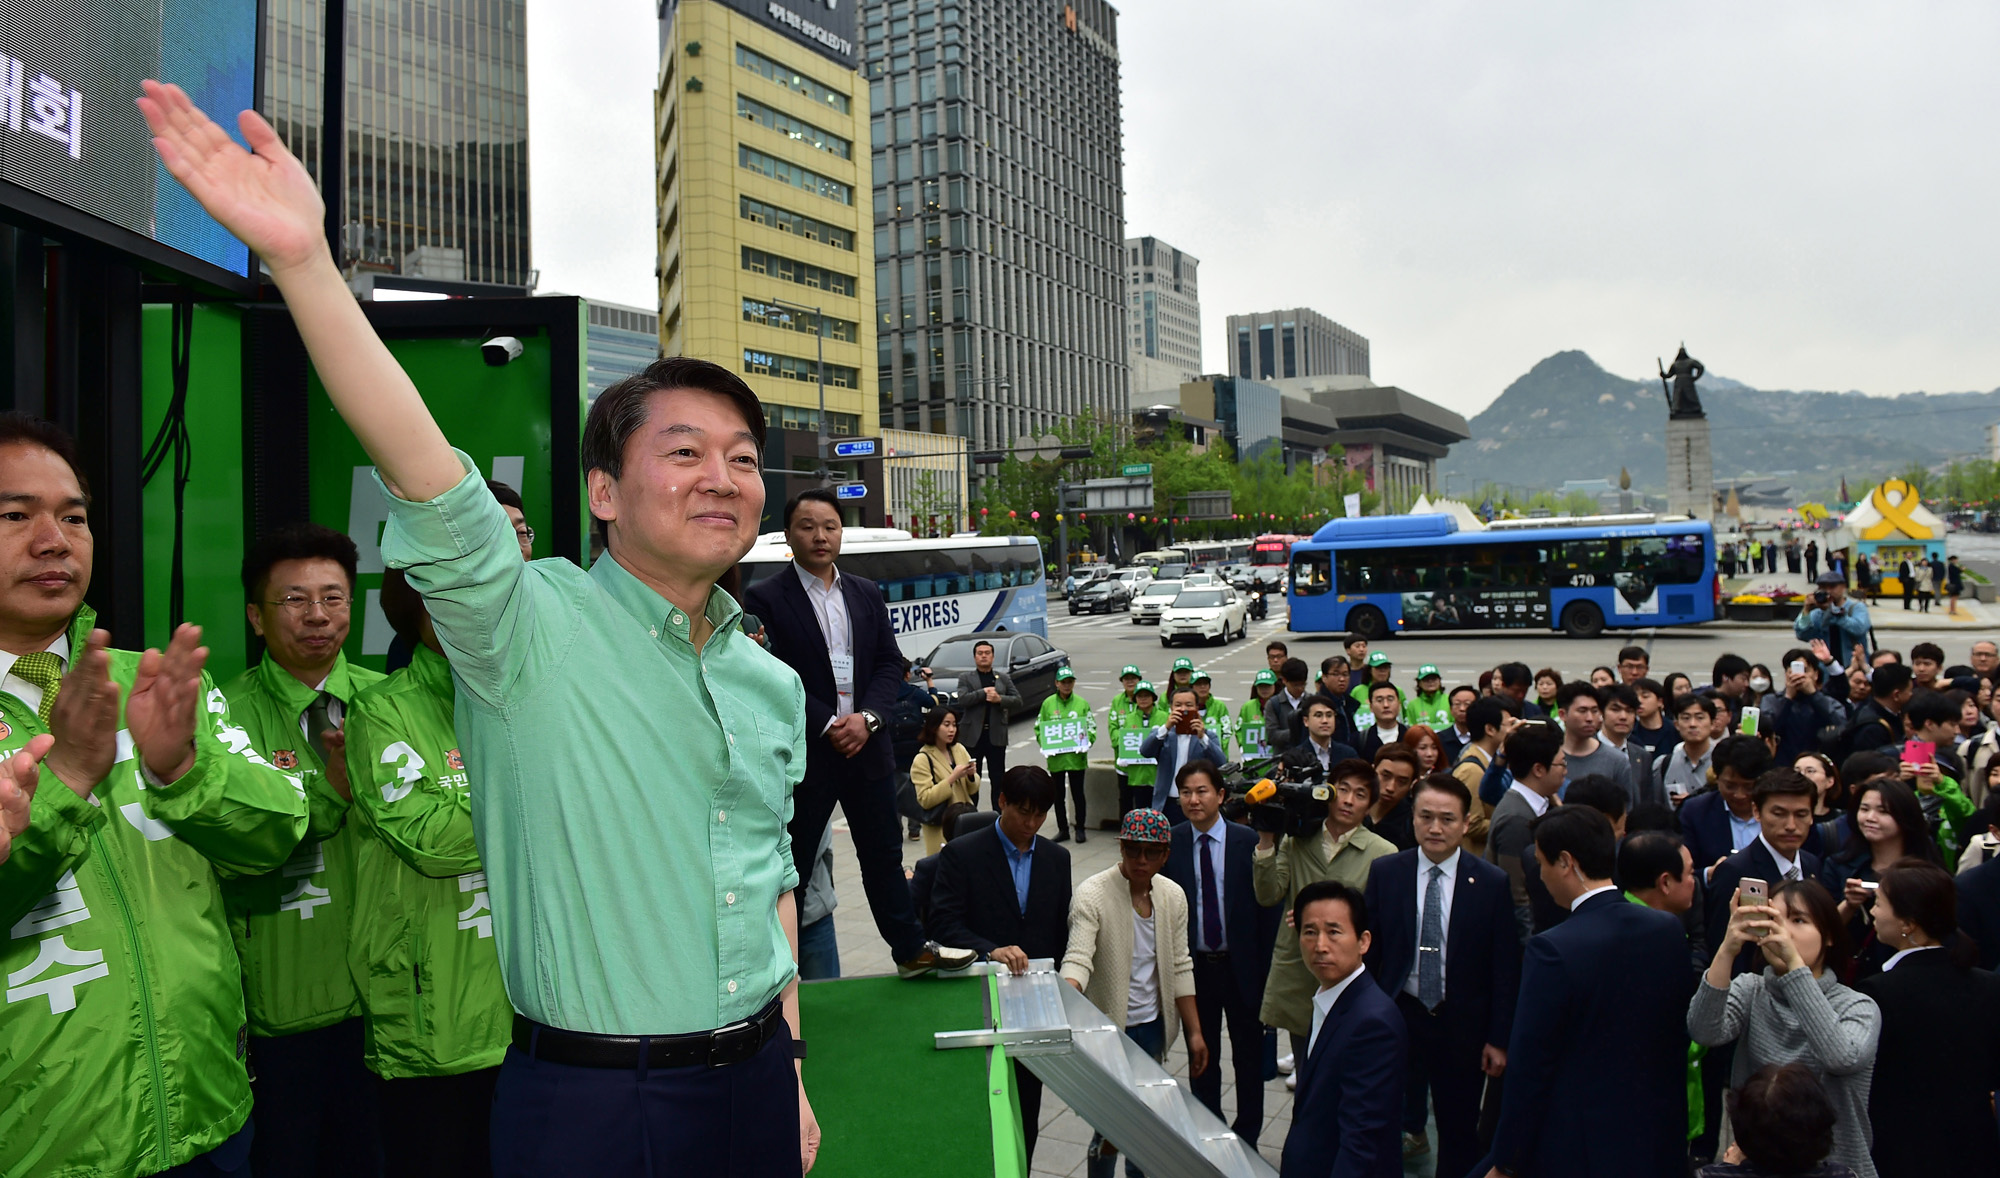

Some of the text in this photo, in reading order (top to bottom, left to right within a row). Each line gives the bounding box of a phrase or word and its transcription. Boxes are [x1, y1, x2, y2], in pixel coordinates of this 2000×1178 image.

[1569, 573, 1596, 587] 470
[890, 599, 960, 634] EXPRESS
[1044, 721, 1083, 745] 변화
[380, 741, 425, 803] 3
